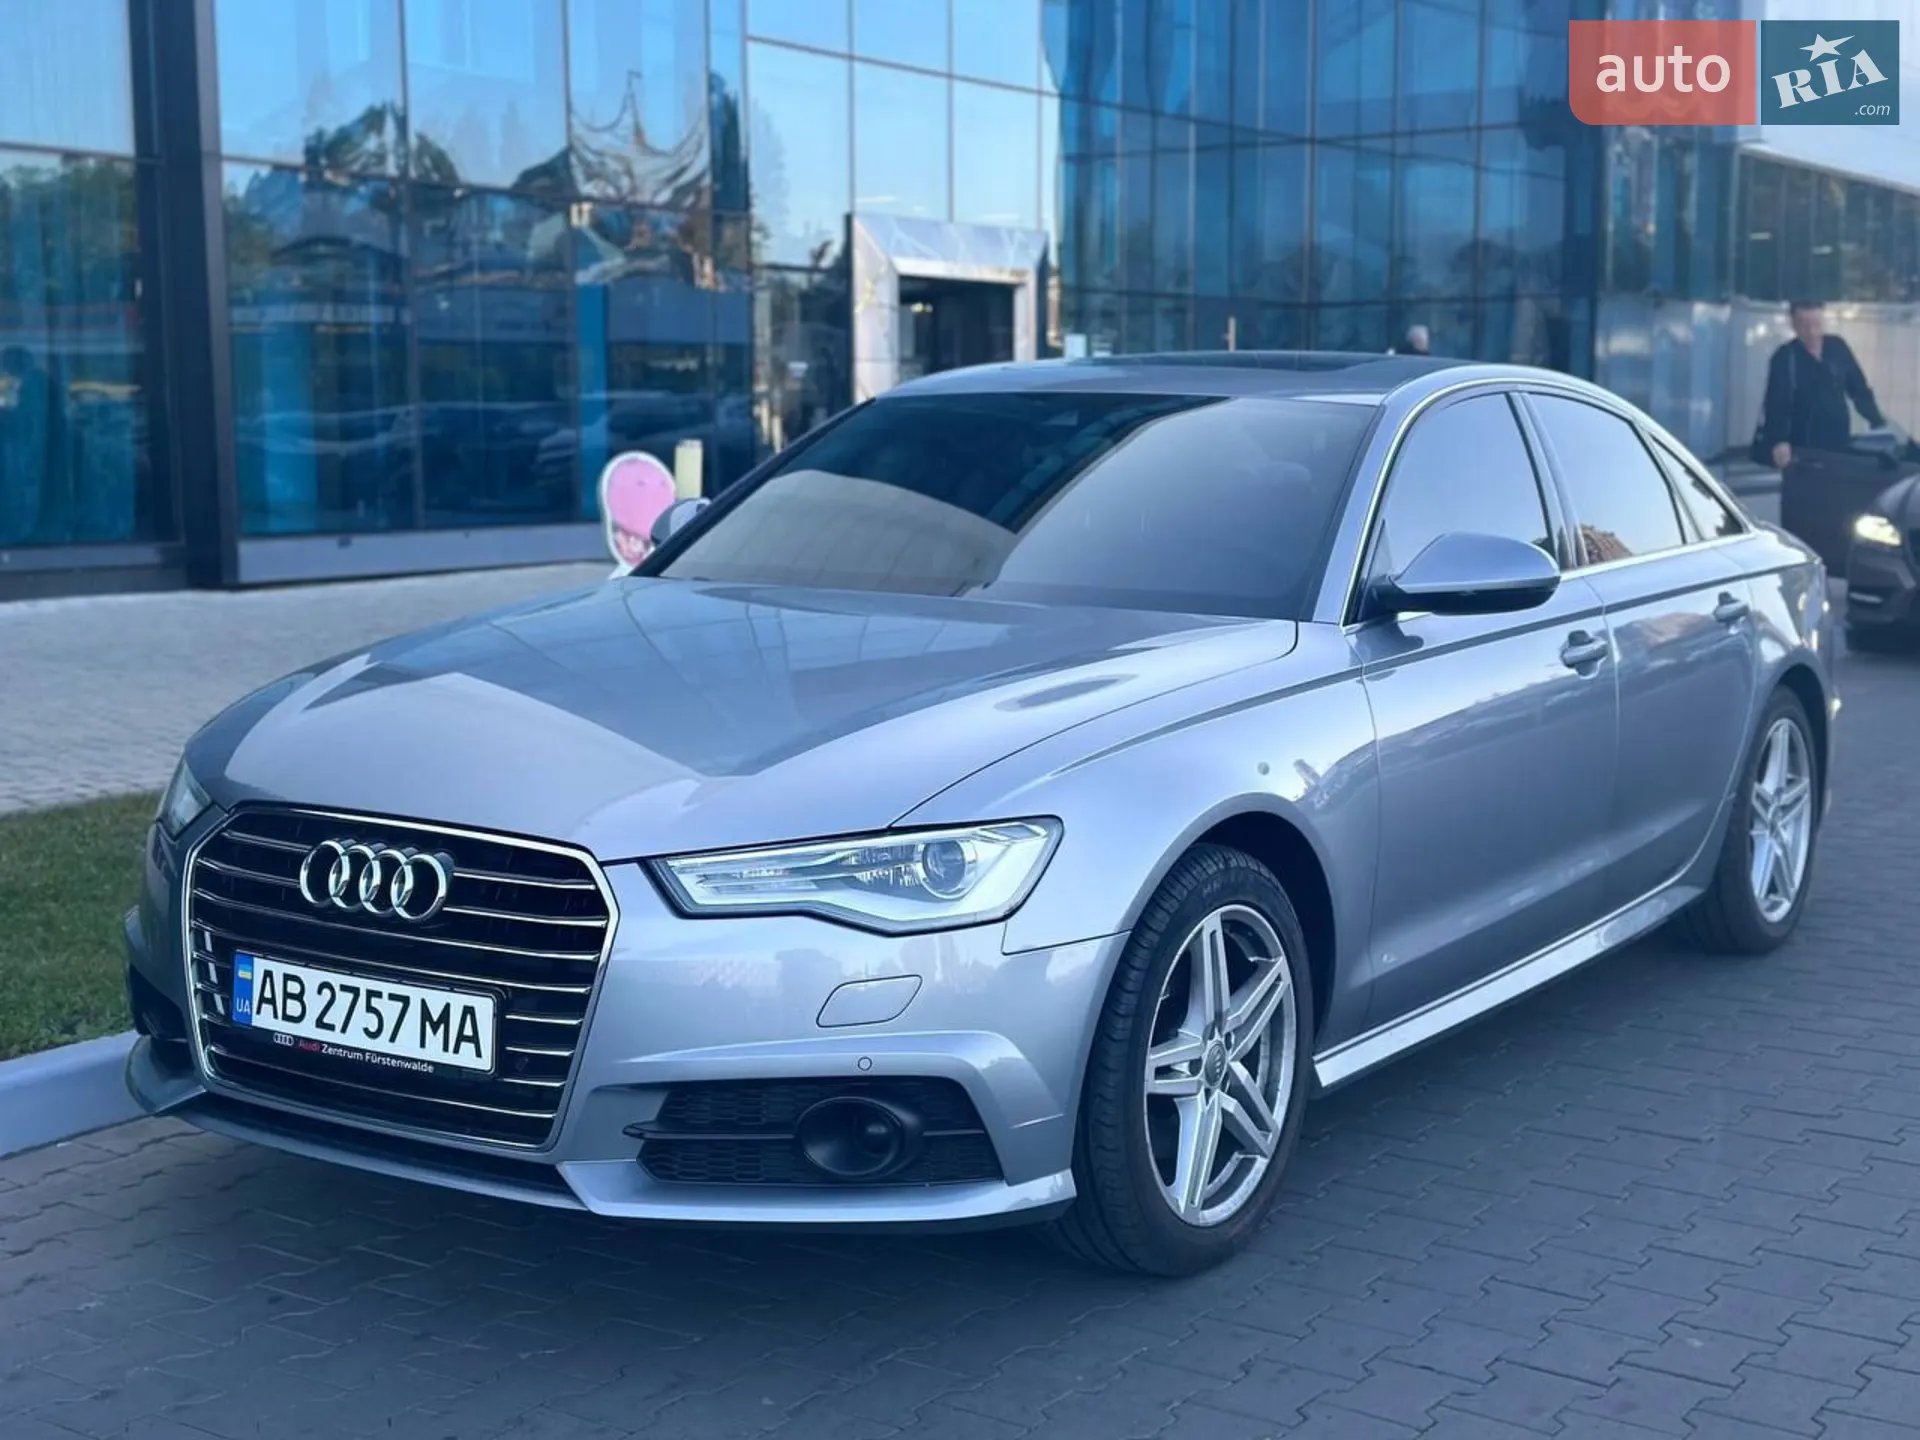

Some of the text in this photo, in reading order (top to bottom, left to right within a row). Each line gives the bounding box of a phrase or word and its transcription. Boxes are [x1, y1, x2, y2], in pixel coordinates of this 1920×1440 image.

[236, 999, 250, 1014] UA
[256, 969, 483, 1058] AB 2757 MA
[298, 1040, 434, 1073] Audi Zentrum Fürstenwalde
